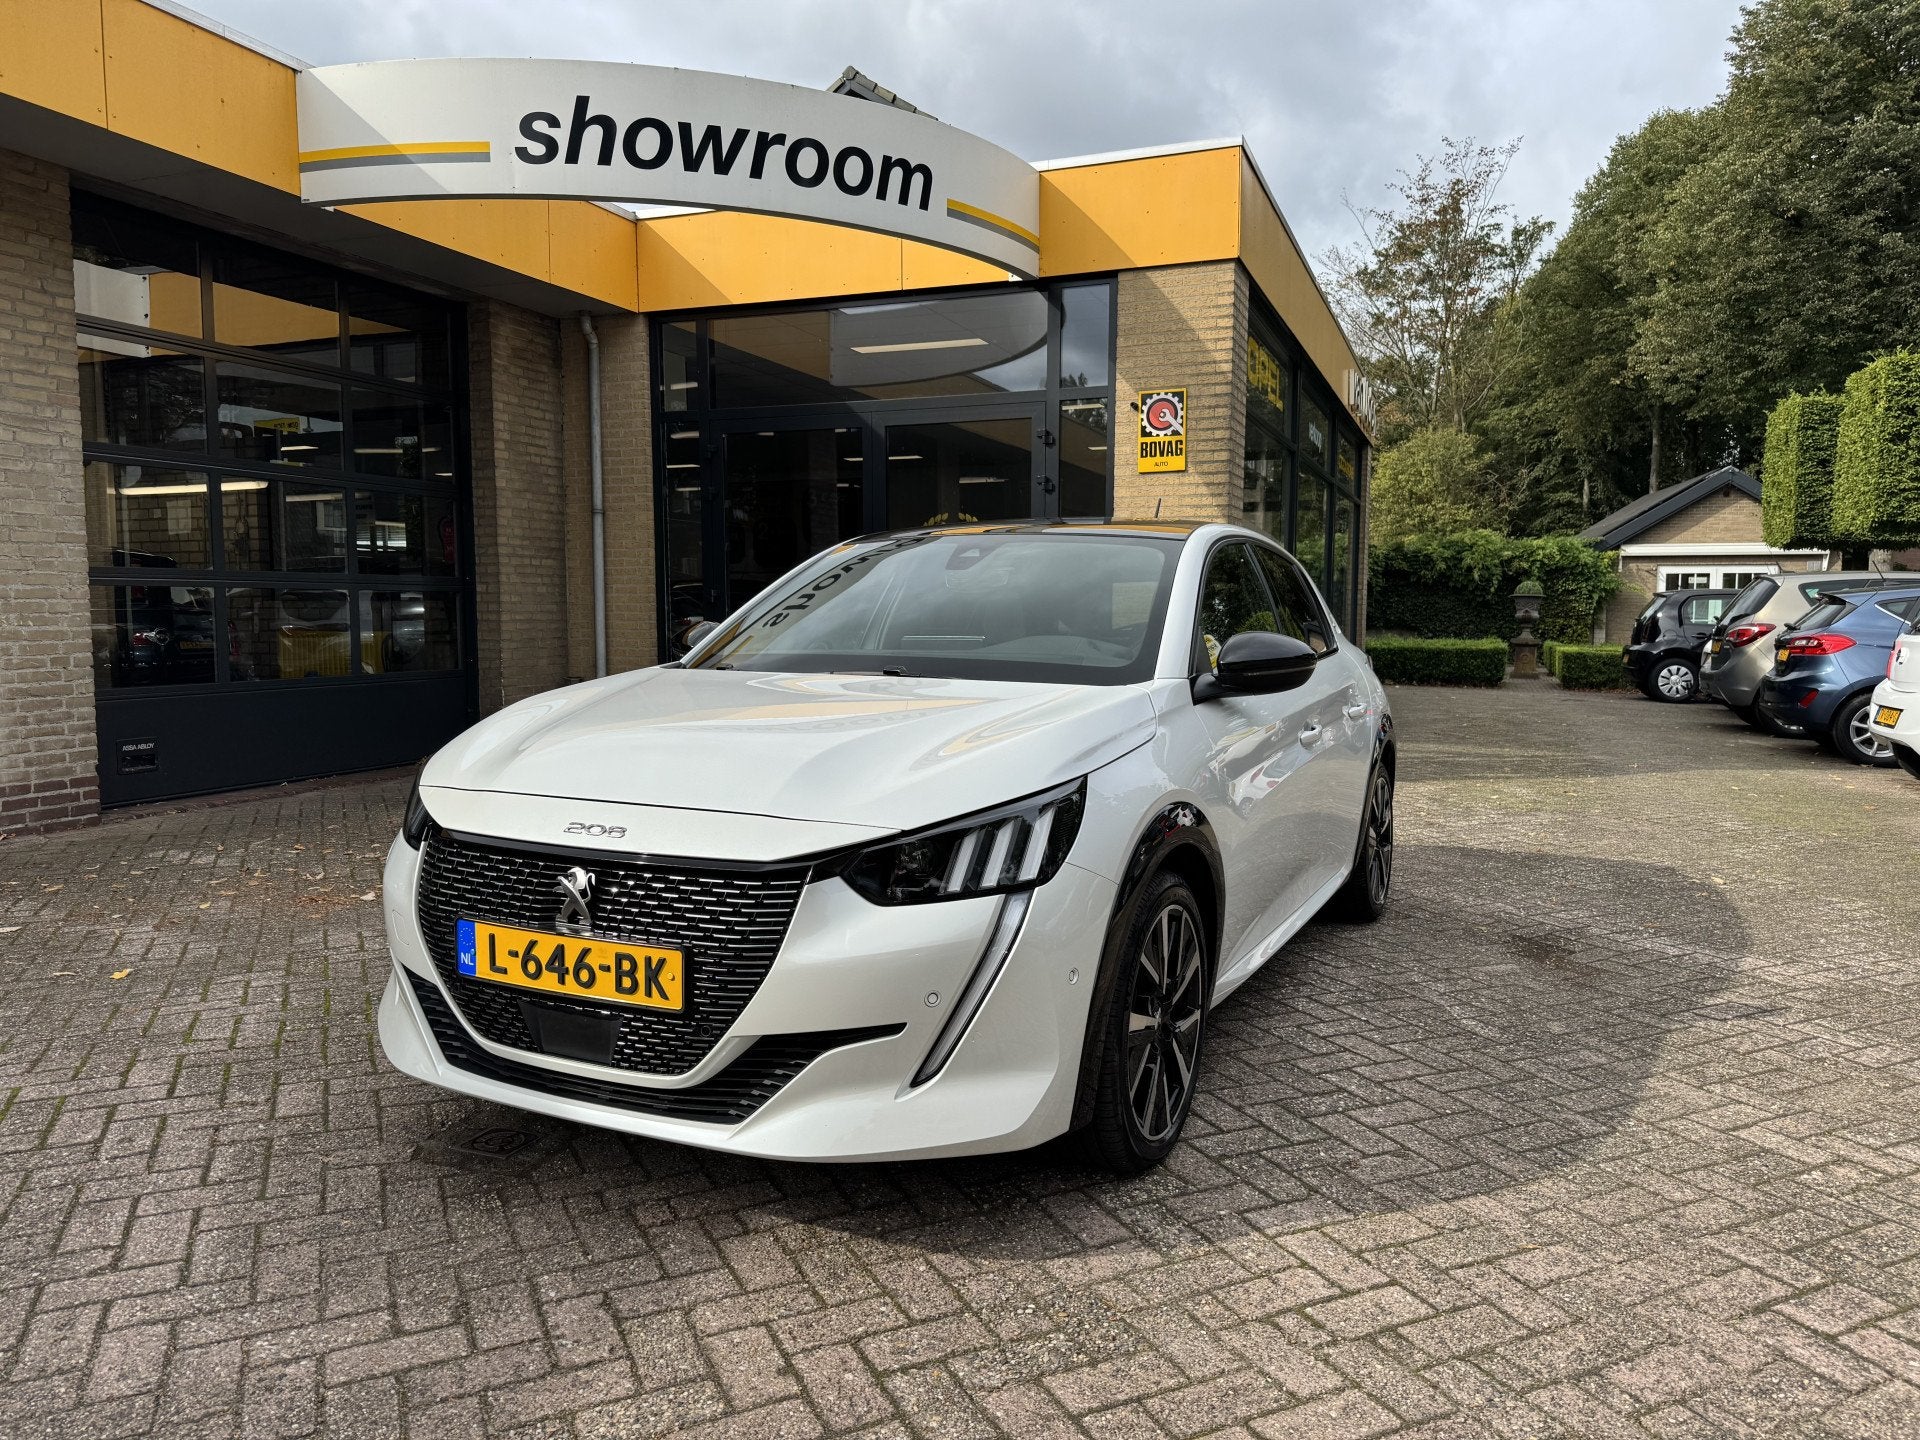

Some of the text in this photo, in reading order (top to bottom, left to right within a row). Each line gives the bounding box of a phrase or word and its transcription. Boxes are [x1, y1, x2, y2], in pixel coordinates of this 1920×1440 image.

[515, 95, 933, 211] showroom
[1140, 440, 1184, 458] BOVAG
[137, 742, 155, 750] ABLOY
[563, 821, 628, 838] 208
[460, 952, 474, 966] NL
[488, 933, 670, 1001] L-646-BK
